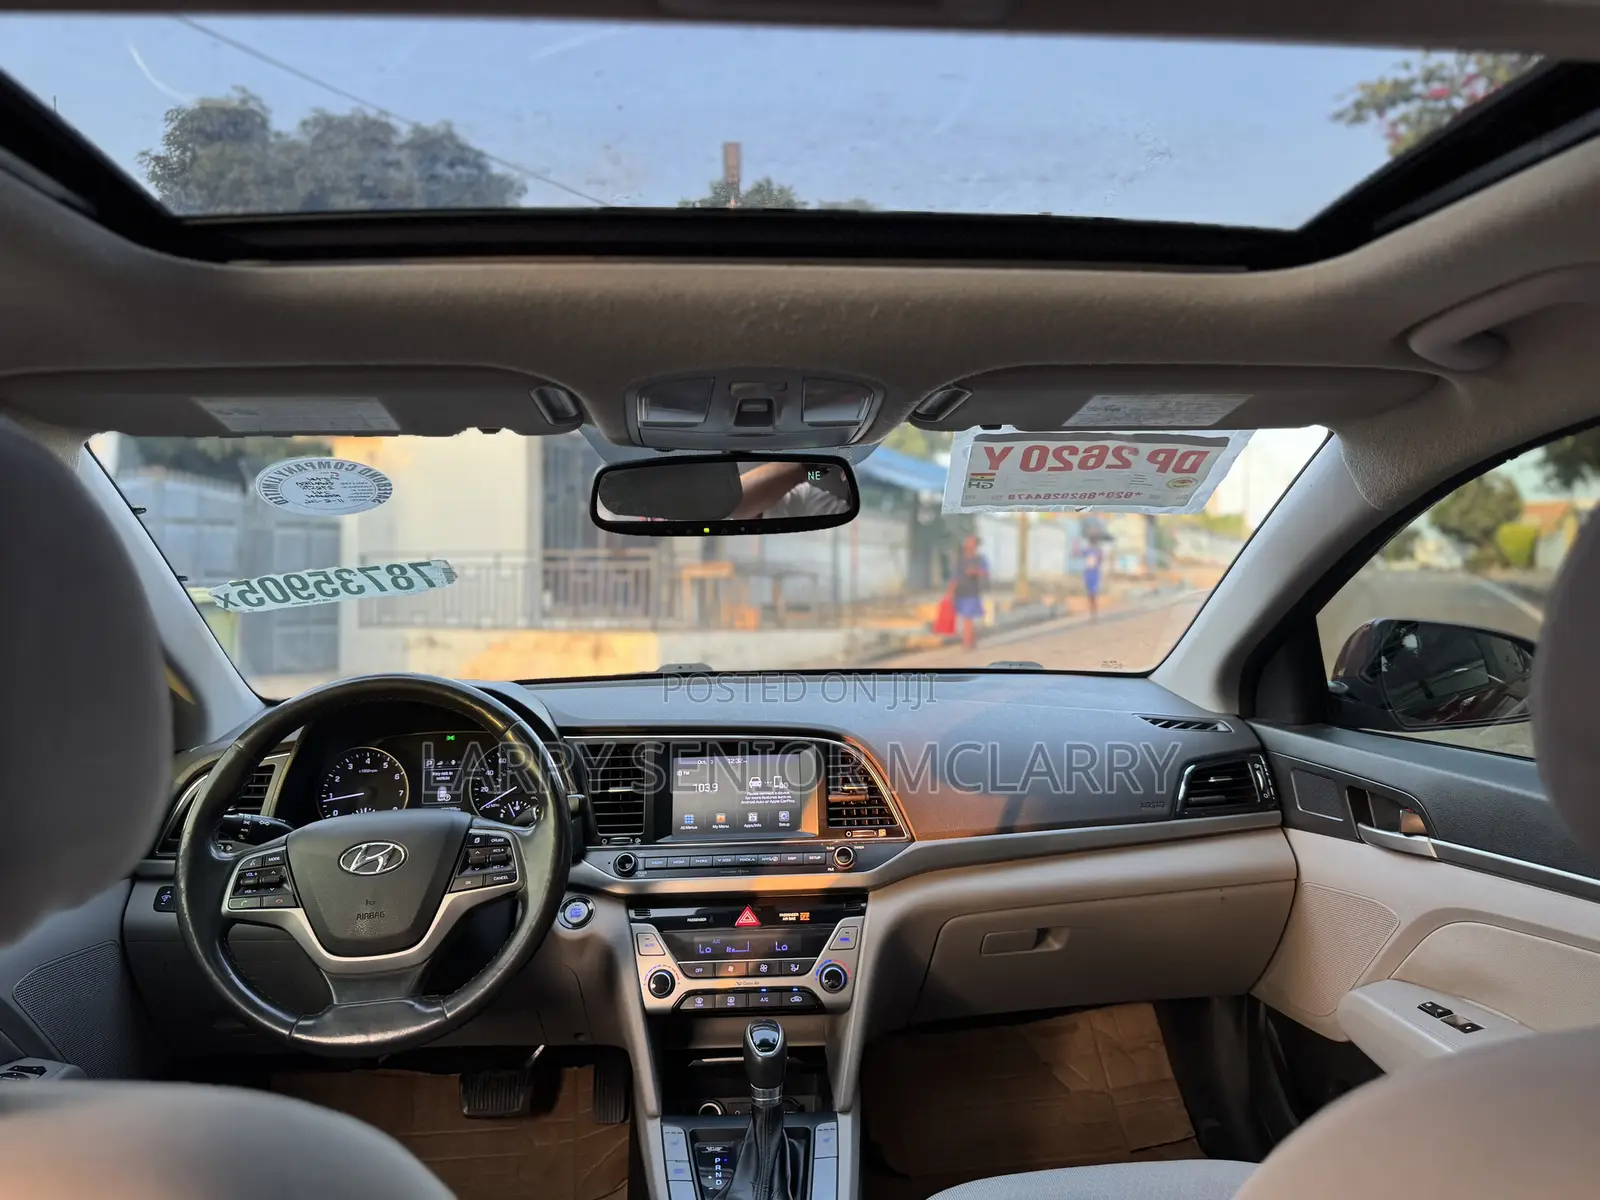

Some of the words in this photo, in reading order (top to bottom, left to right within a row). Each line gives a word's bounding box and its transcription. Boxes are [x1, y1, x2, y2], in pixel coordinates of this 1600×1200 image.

[808, 471, 821, 480] NE
[693, 783, 719, 793] 103.9
[356, 911, 386, 920] AIRBAG
[699, 943, 712, 953] Lo
[776, 941, 788, 951] Lo
